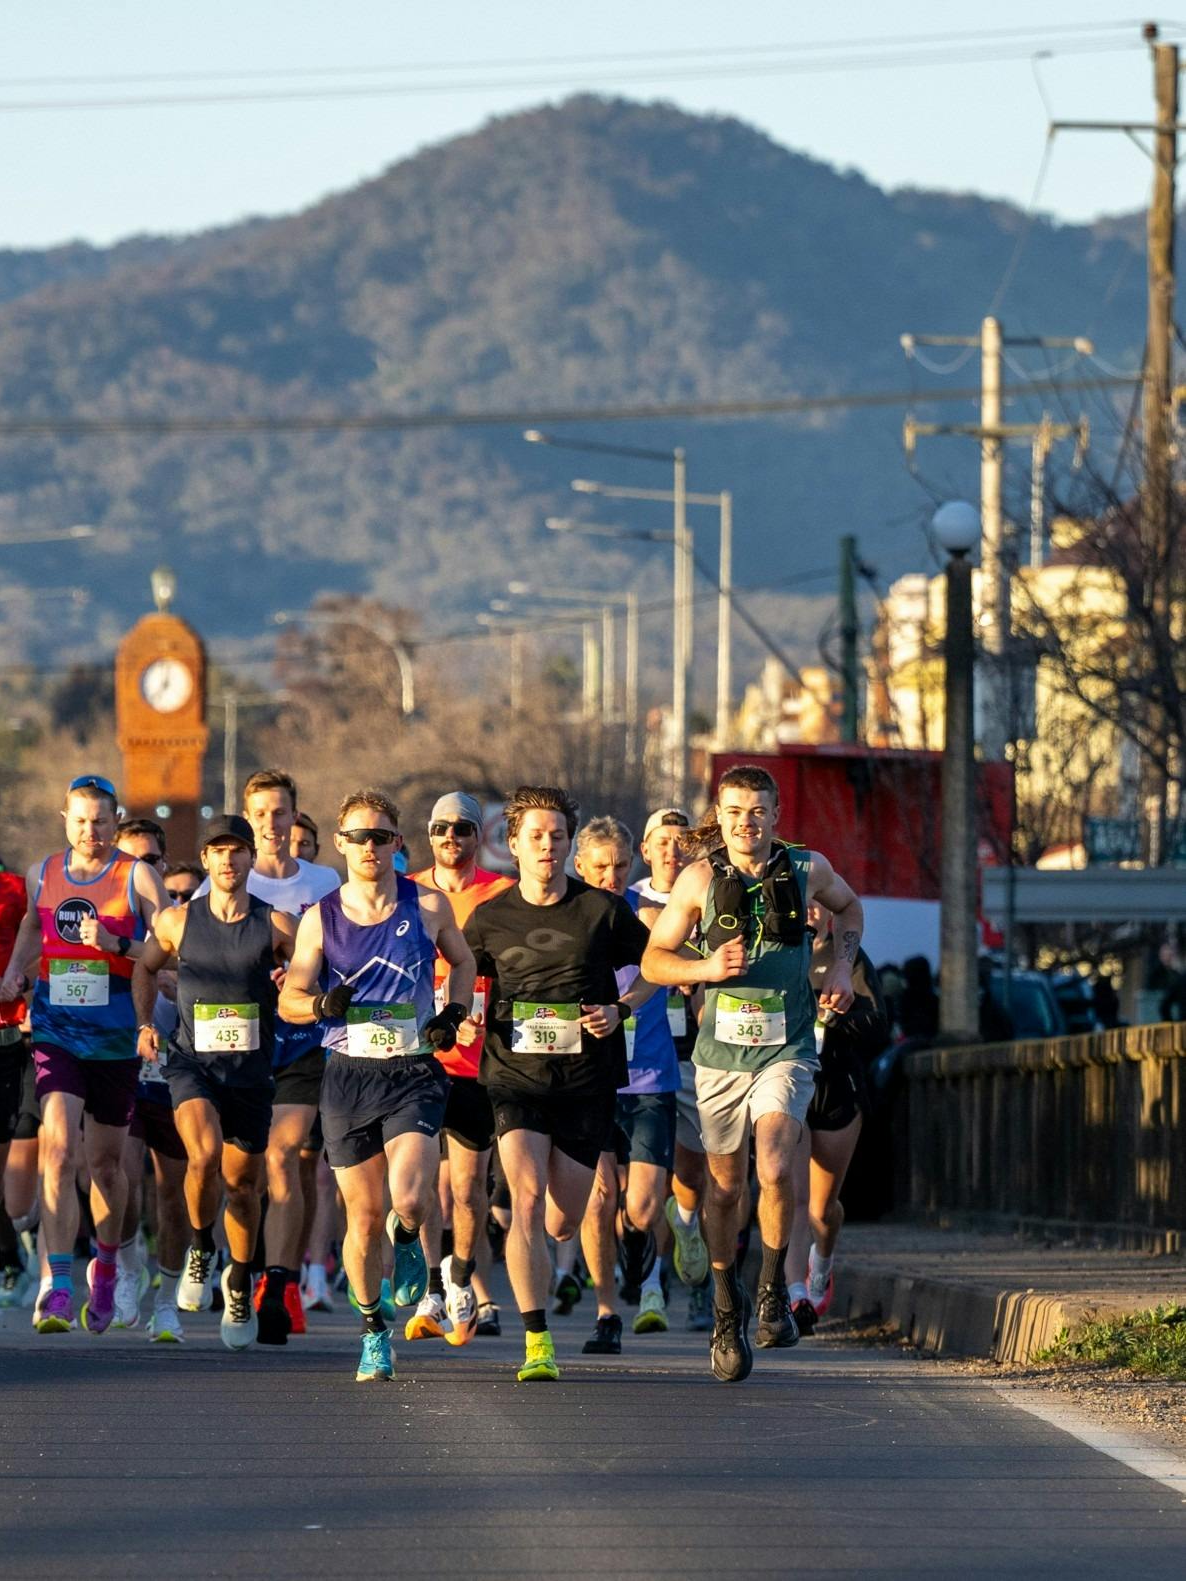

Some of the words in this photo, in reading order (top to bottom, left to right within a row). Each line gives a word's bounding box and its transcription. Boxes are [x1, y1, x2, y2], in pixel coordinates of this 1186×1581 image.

[58, 910, 76, 921] RUN
[66, 984, 89, 997] 567
[216, 1029, 240, 1042] 435
[736, 1023, 763, 1037] 343
[370, 1031, 396, 1047] 458
[534, 1030, 557, 1044] 319
